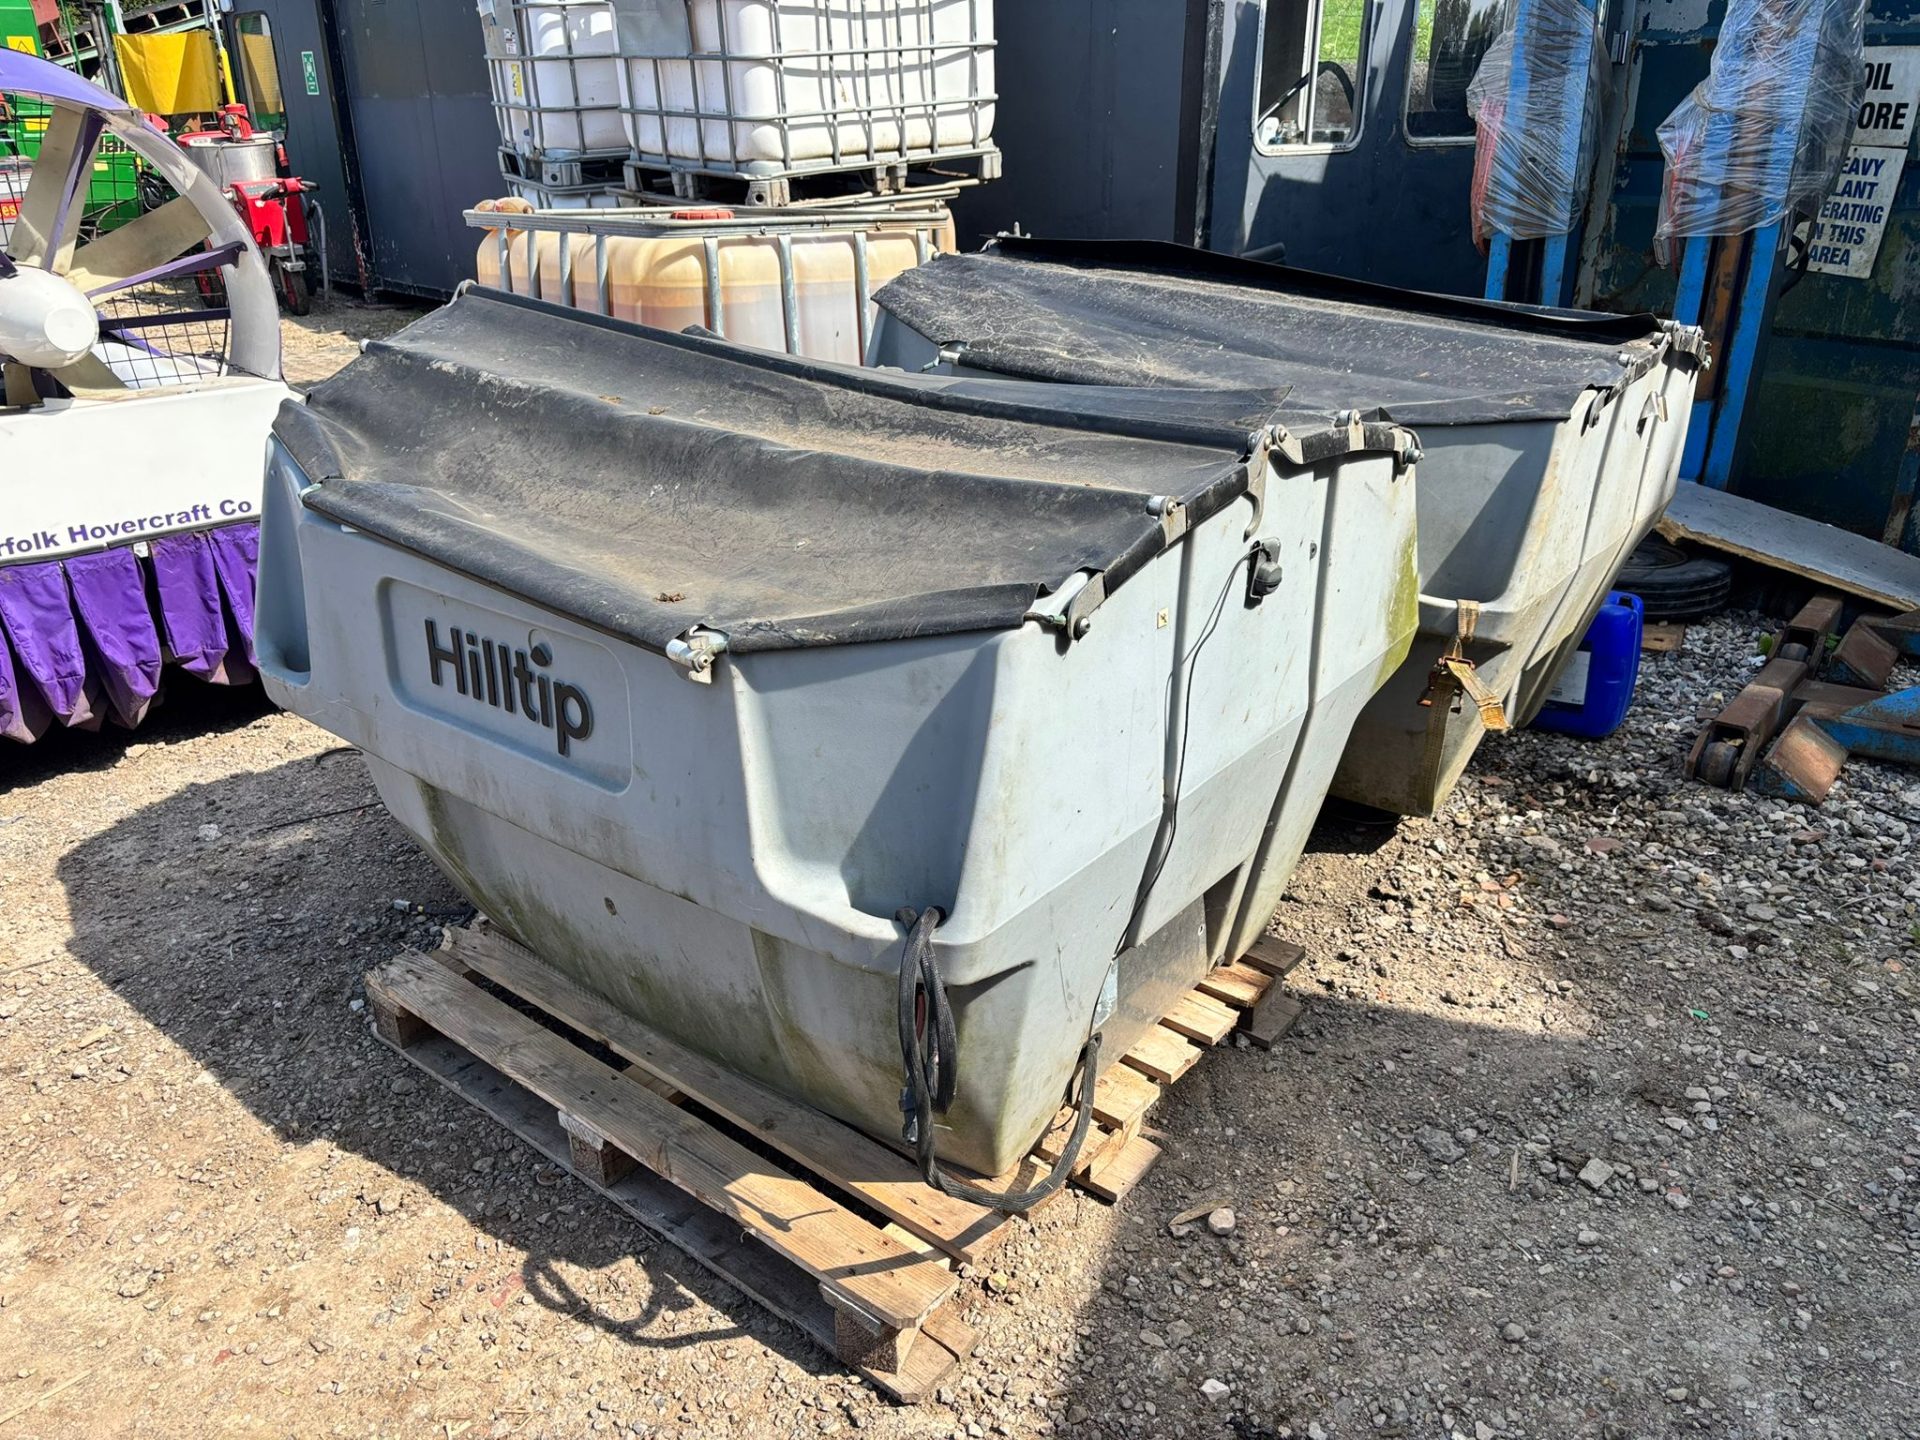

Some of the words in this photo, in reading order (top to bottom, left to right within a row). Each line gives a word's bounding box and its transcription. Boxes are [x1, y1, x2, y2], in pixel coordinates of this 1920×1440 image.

[1857, 101, 1910, 130] ORE
[1829, 223, 1867, 246] THIS
[1808, 244, 1851, 267] AREA
[67, 503, 212, 544] Hovercraft
[219, 499, 253, 517] Co
[424, 617, 595, 758] Hilltip
